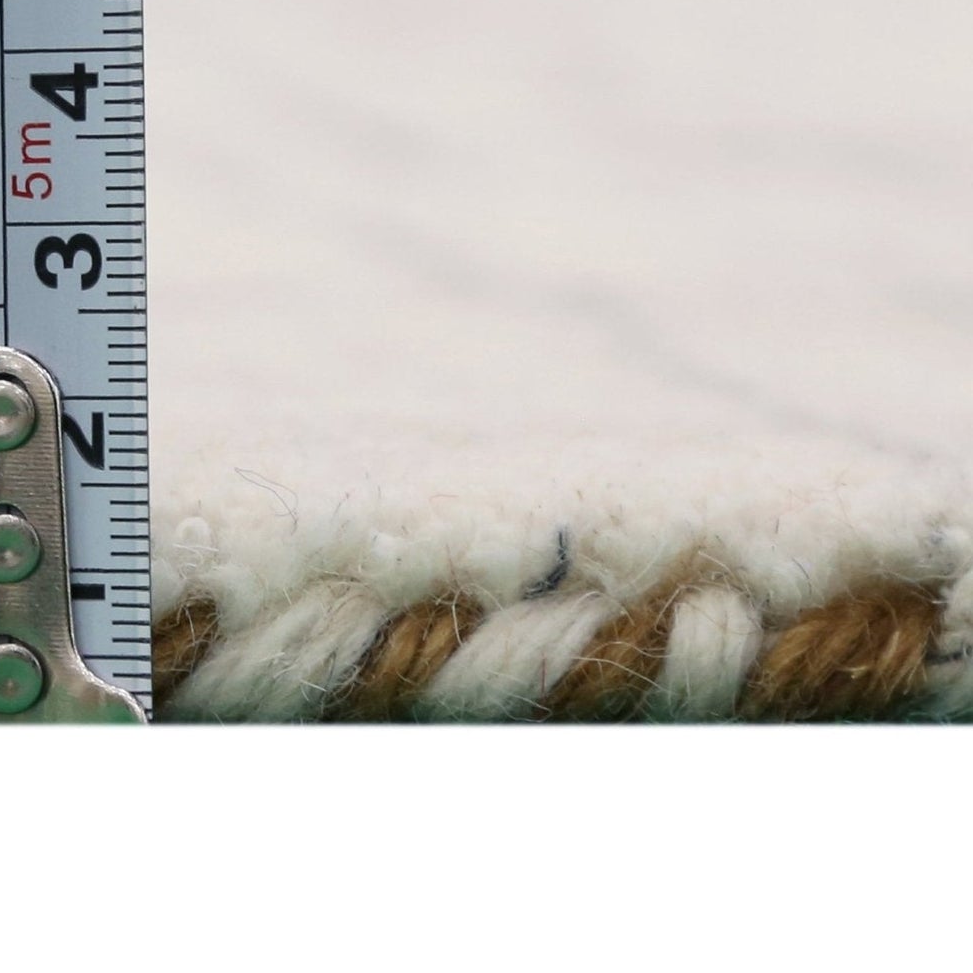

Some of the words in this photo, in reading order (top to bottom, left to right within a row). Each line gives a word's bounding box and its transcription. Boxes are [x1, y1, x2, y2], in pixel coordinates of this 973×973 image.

[31, 63, 98, 122] 4
[12, 122, 52, 200] 5m
[35, 234, 103, 291] 3
